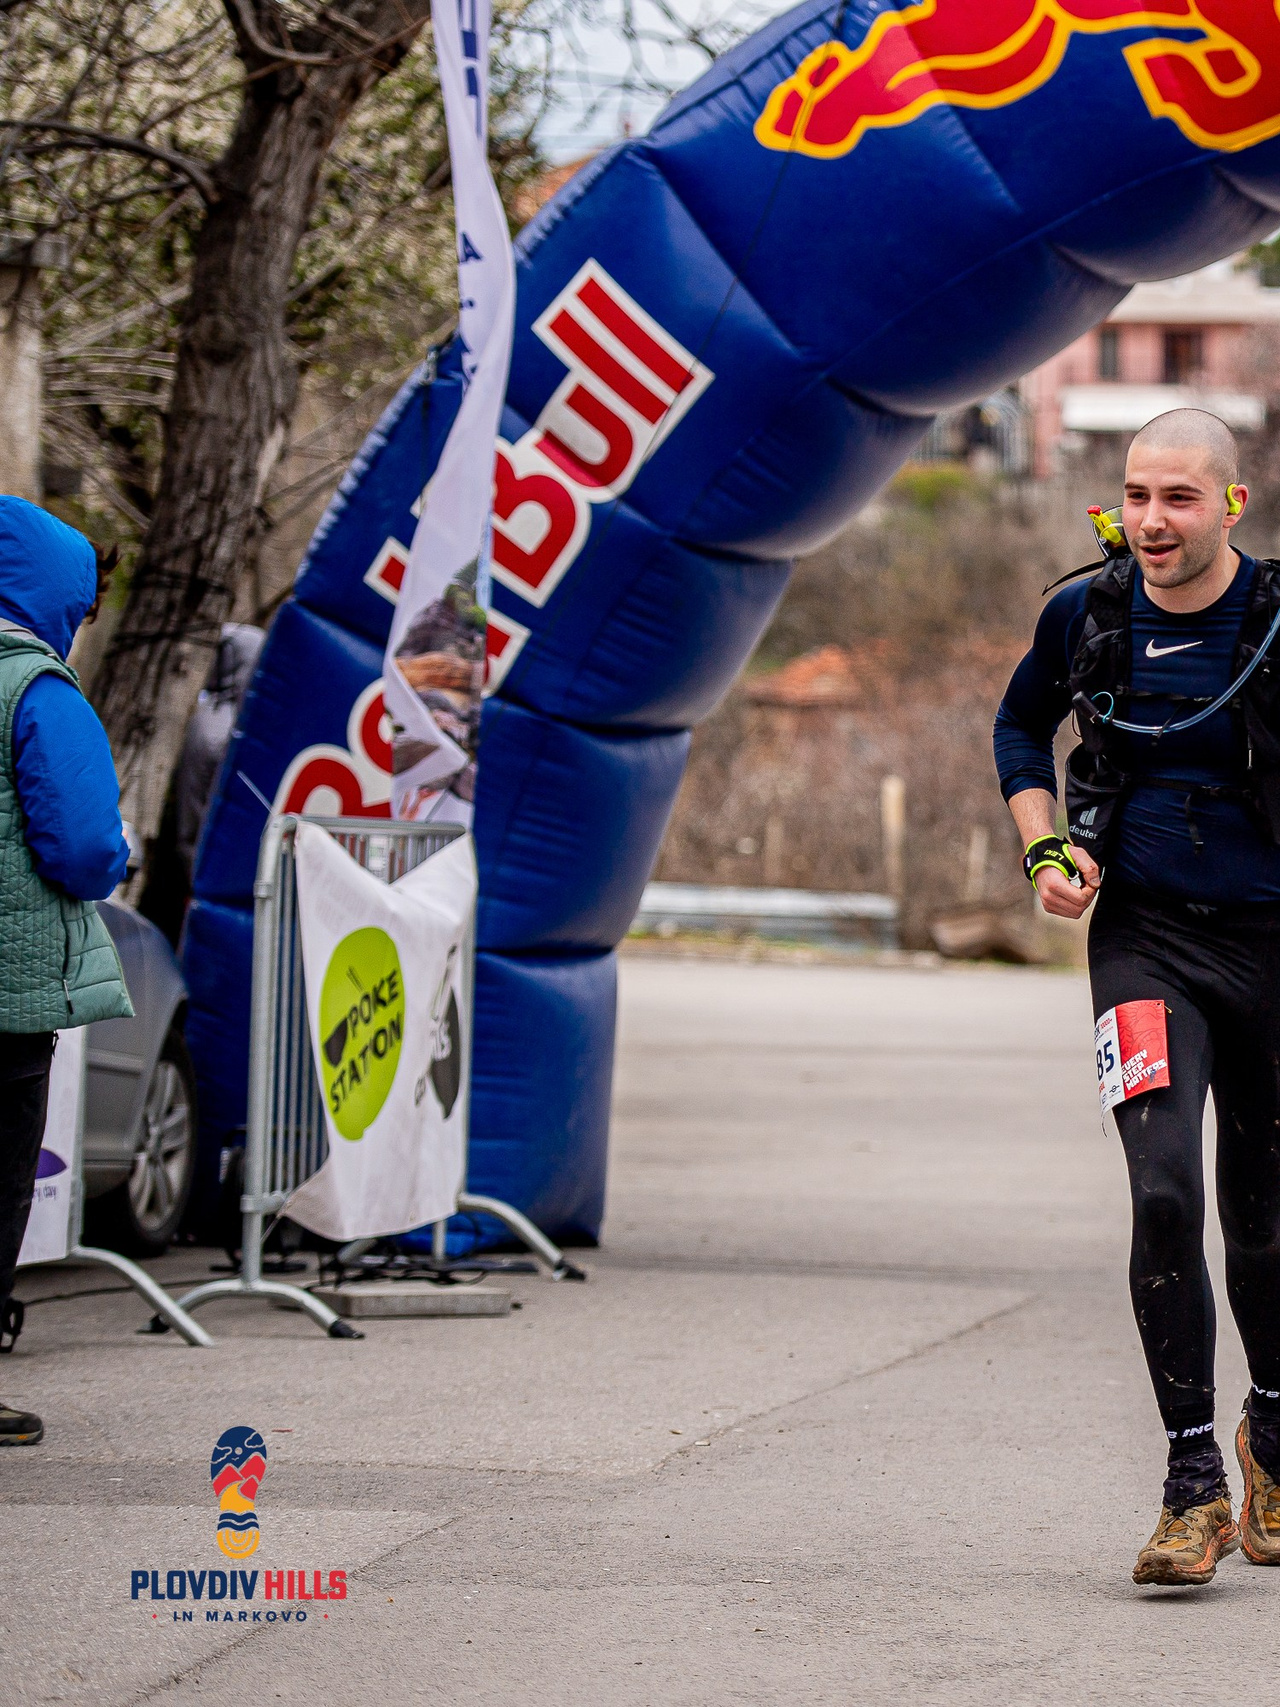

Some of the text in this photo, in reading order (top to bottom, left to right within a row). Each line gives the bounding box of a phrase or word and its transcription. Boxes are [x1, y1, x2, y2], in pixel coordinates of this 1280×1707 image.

[1069, 825, 1098, 840] deuter
[348, 969, 399, 1038] POKE
[1096, 1040, 1115, 1081] 85
[1122, 1061, 1145, 1083] STEP
